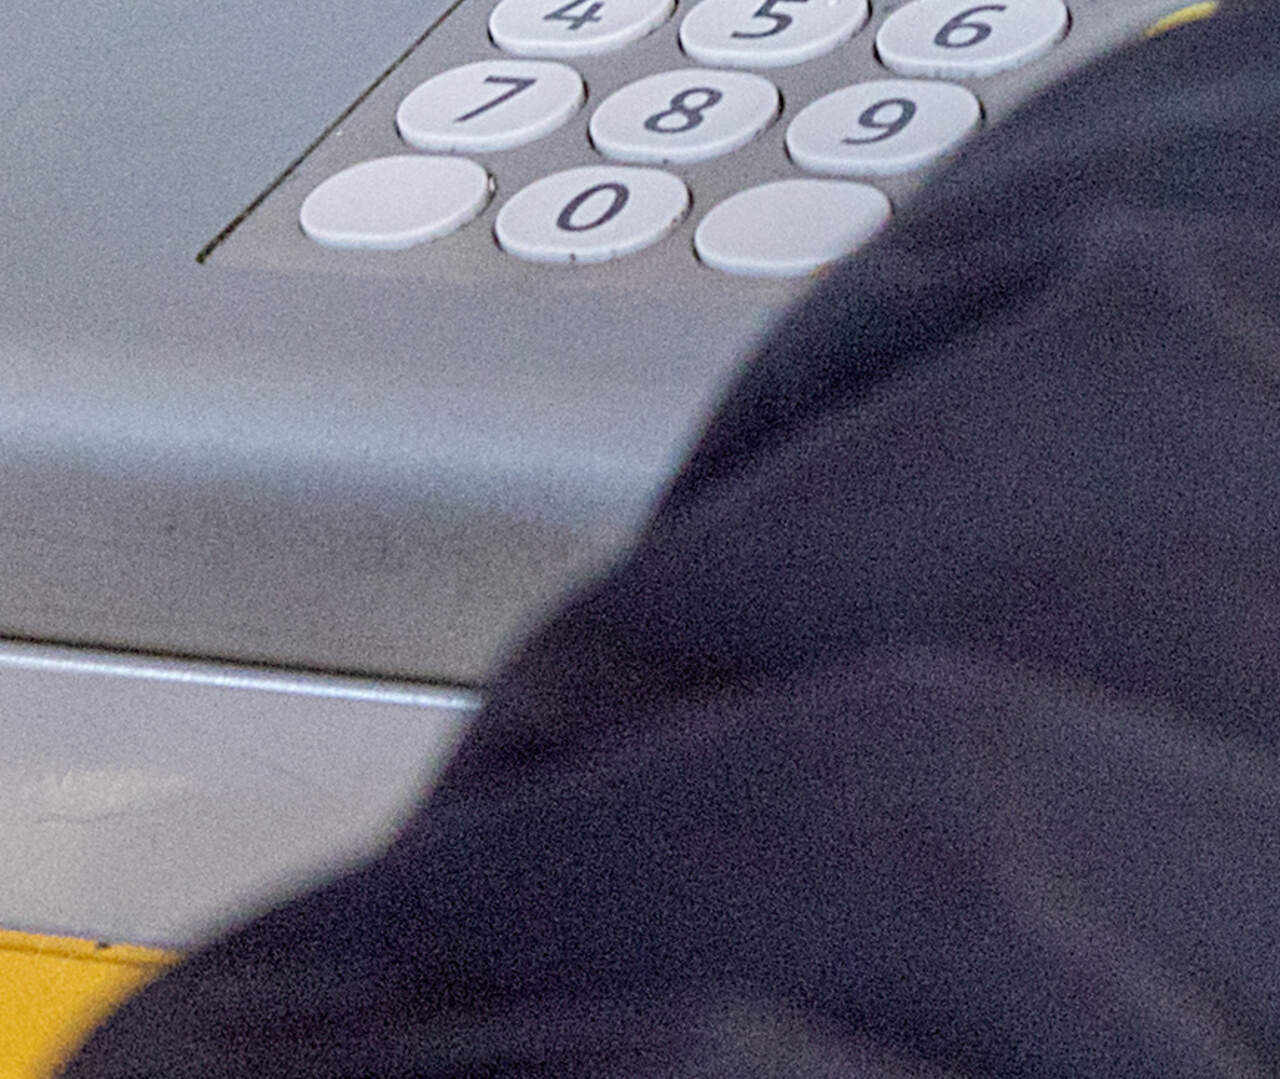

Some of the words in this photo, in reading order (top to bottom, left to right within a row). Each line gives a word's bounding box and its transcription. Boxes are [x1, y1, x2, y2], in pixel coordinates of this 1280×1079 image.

[932, 3, 1008, 50] 6
[456, 75, 537, 123] 7
[642, 86, 724, 135] 8
[841, 97, 918, 147] 9
[555, 181, 631, 234] 0
